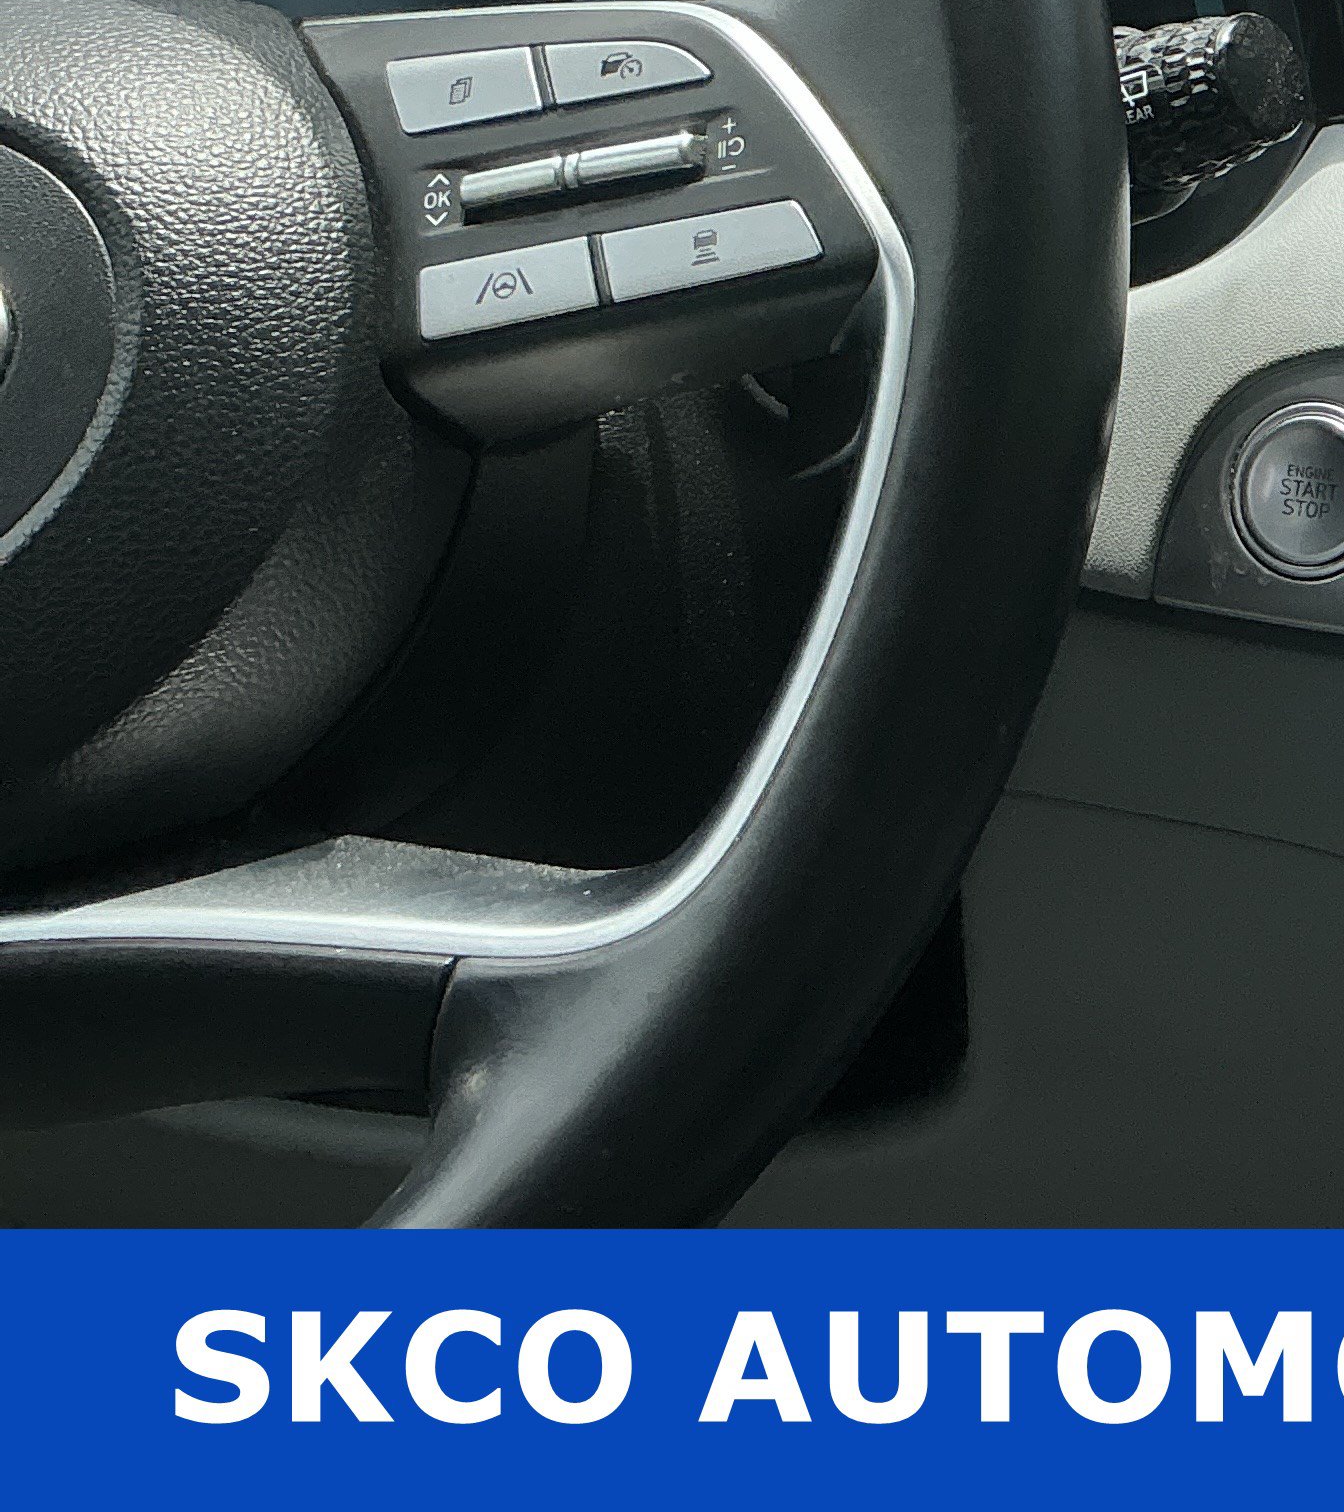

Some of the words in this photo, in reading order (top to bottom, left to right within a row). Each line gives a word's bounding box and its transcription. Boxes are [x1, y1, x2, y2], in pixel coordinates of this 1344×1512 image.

[423, 190, 452, 210] OK
[1287, 464, 1336, 480] ENGINE
[1279, 478, 1338, 502] START
[1281, 498, 1331, 519] STOP
